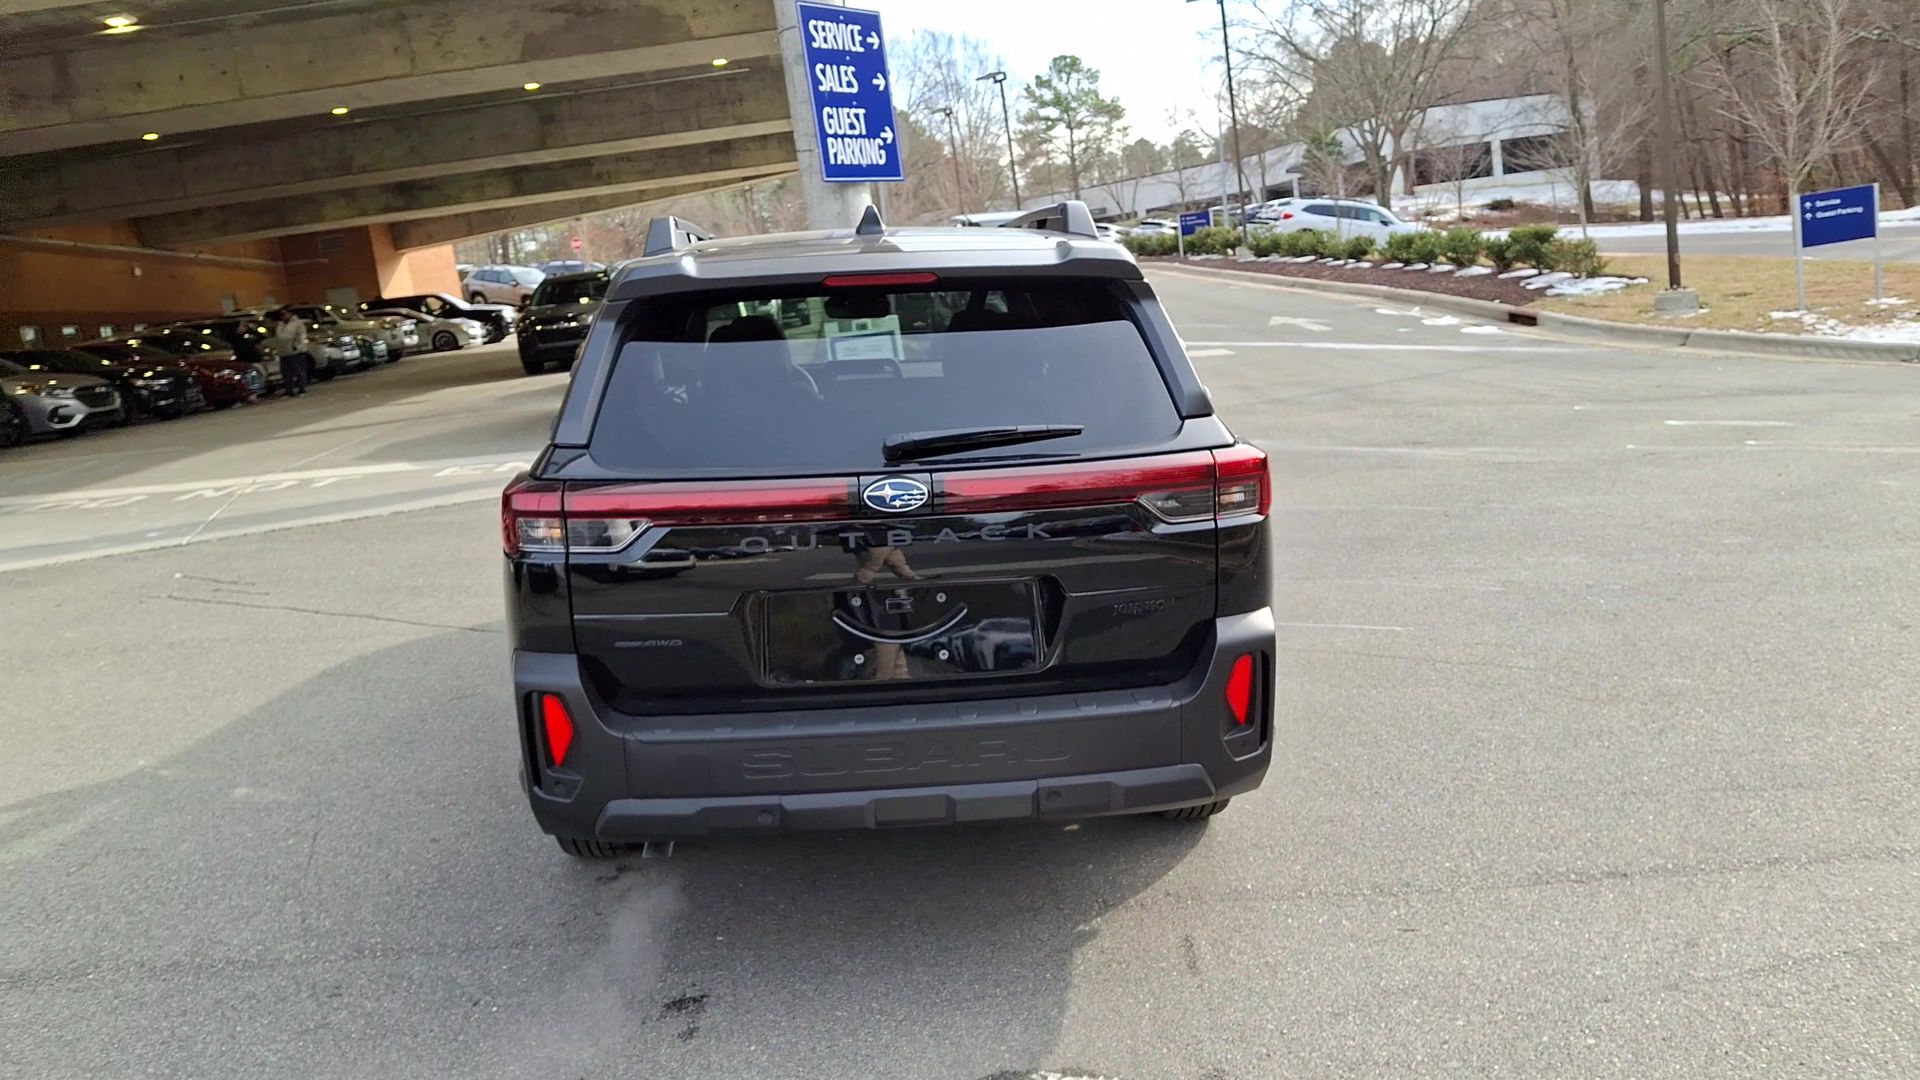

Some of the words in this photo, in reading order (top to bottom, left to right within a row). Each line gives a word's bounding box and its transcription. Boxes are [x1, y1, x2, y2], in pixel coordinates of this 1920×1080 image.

[808, 19, 865, 52] SERVICE
[815, 63, 859, 93] SALES
[822, 106, 867, 136] GUEST
[826, 137, 887, 166] PARKING
[740, 522, 1050, 553] OUTBACK
[741, 737, 1074, 780] SUBARU
